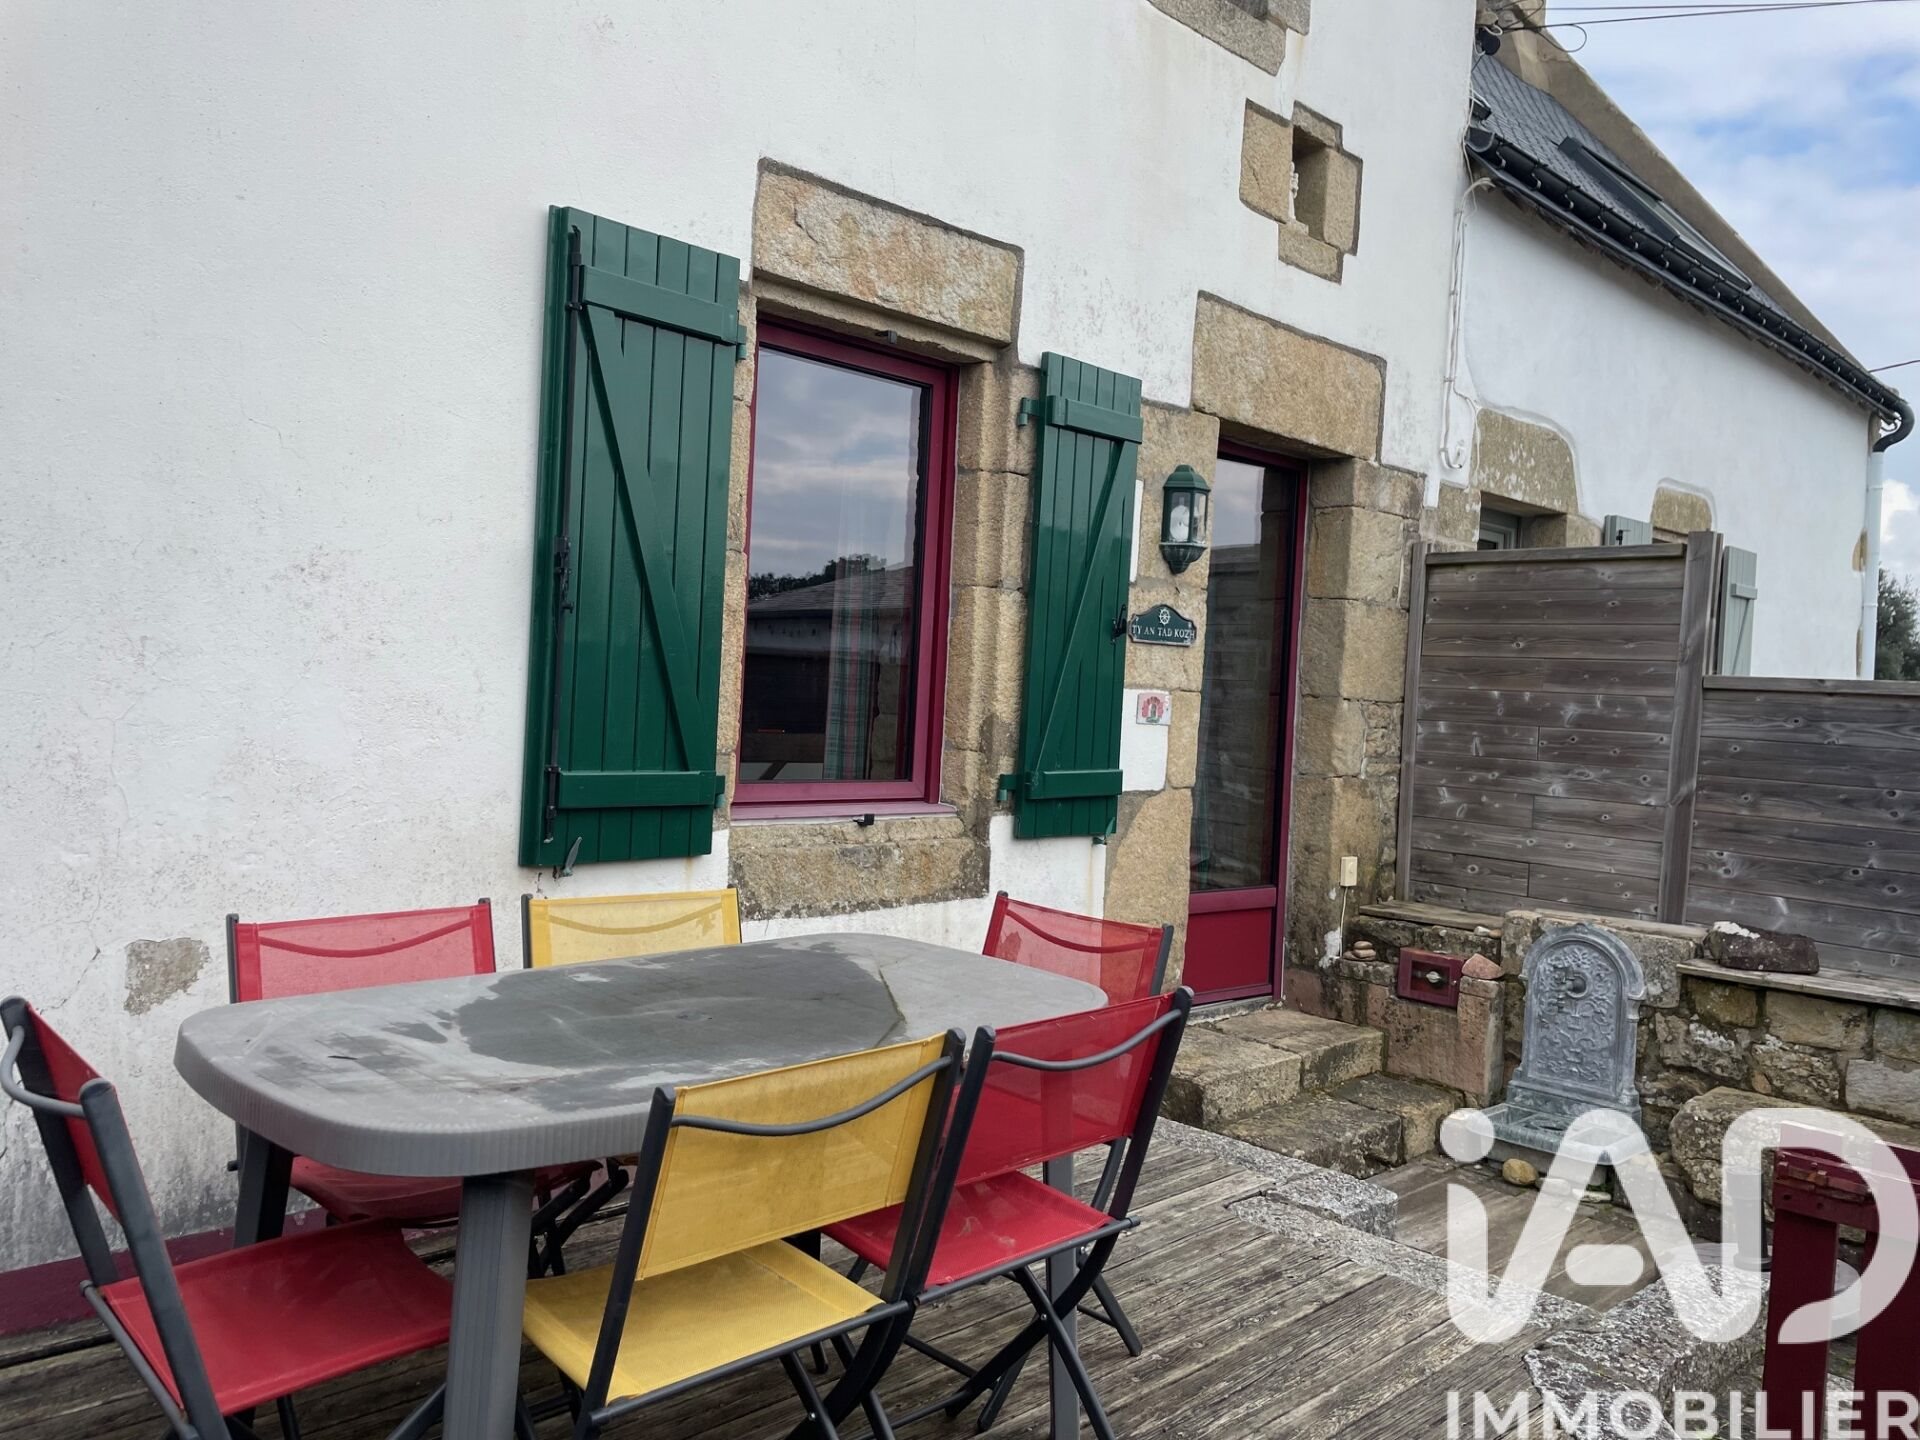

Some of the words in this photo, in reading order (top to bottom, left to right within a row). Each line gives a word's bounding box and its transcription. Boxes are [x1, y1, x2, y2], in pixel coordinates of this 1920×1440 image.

[1132, 625, 1141, 634] TY
[1144, 627, 1155, 635] AN
[1157, 628, 1173, 637] TAD
